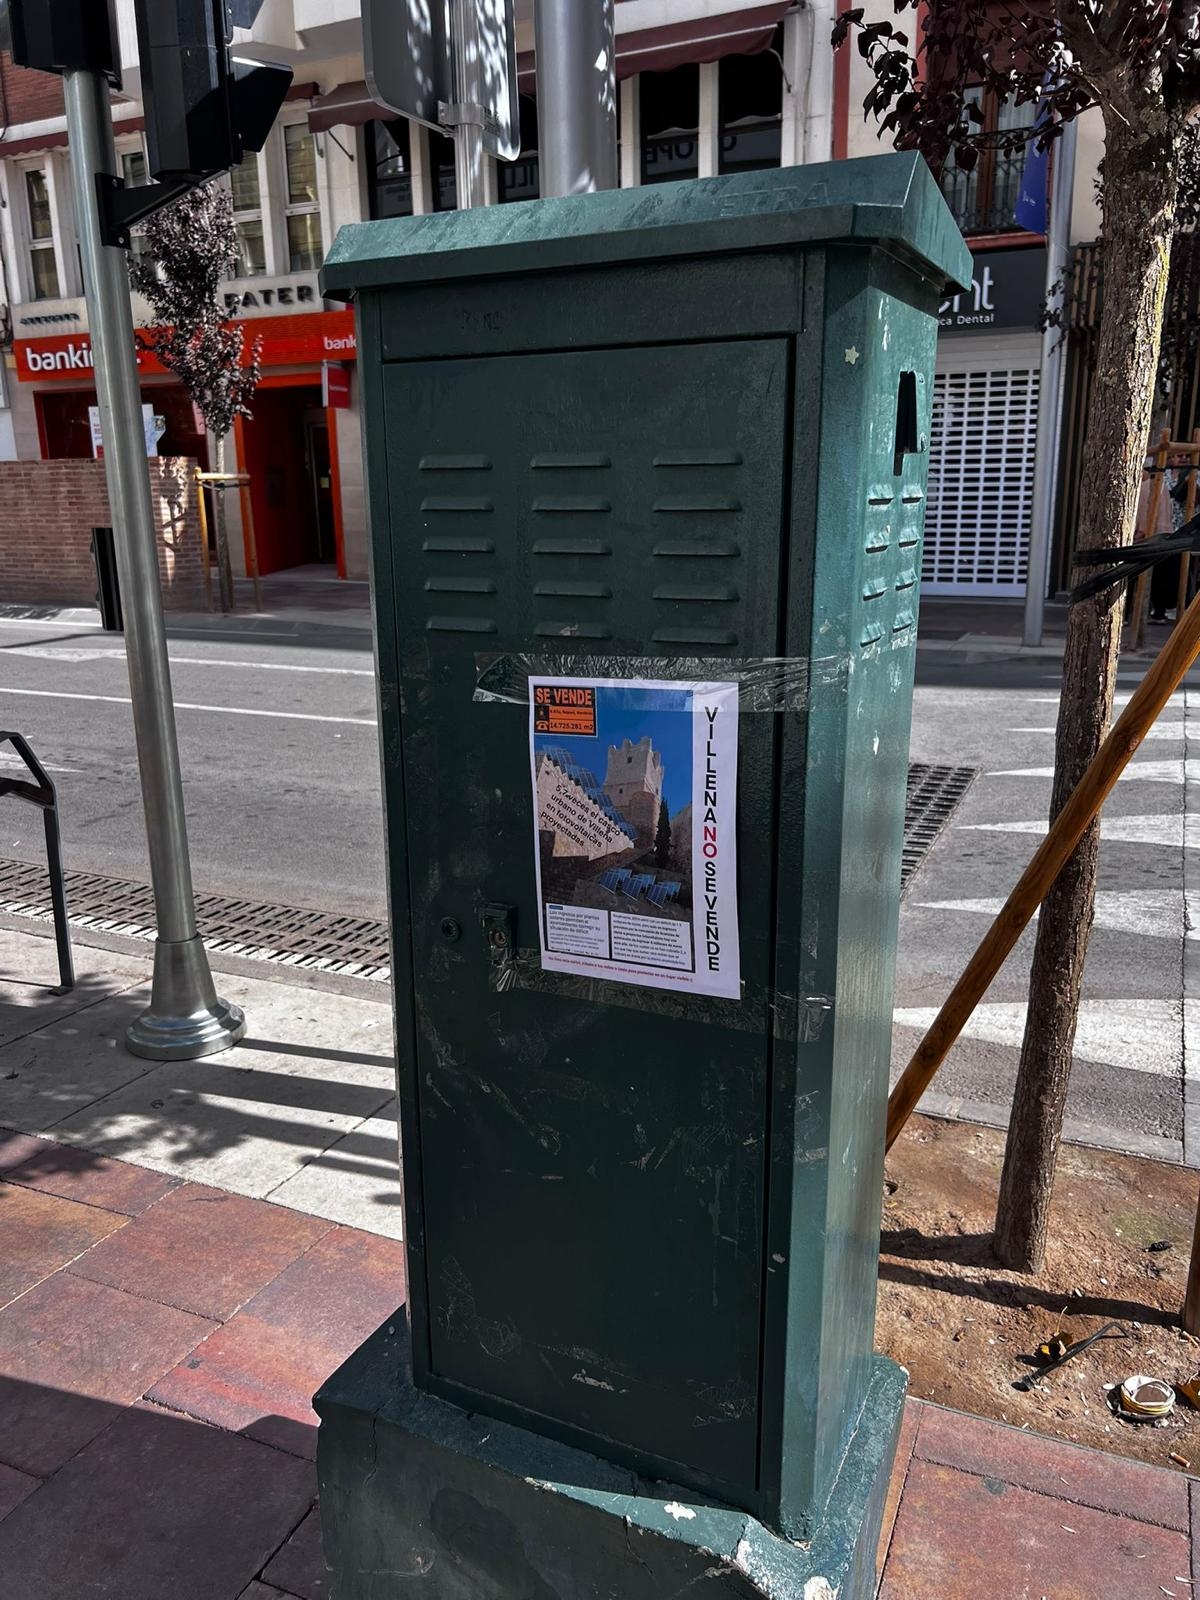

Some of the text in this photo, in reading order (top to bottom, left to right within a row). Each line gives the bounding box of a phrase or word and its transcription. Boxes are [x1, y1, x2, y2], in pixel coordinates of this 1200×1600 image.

[957, 313, 994, 325] Dental
[536, 688, 593, 705] SE VENDE
[541, 811, 585, 847] proyectadas
[546, 803, 602, 847] en fotovoltaicas
[551, 794, 612, 843] urbano de Villena
[568, 794, 589, 813] veces
[590, 811, 599, 819] el
[598, 816, 620, 836] casco
